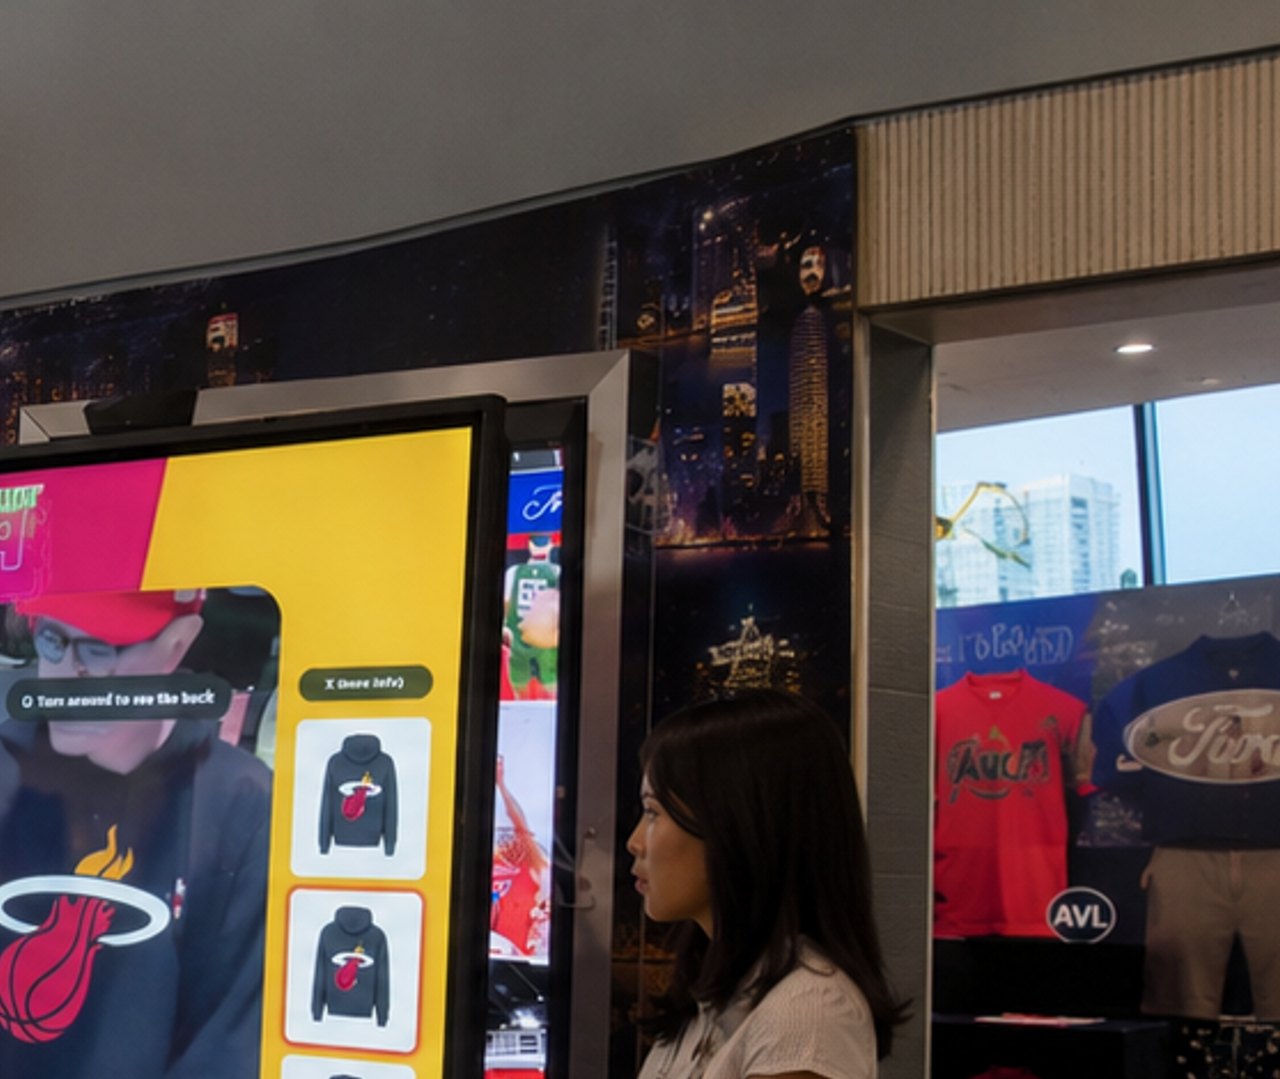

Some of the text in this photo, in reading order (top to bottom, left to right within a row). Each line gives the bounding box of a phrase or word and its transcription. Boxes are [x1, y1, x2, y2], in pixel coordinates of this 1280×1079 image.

[67, 692, 112, 706] around
[115, 693, 130, 706] to
[1053, 903, 1108, 928] AVL
